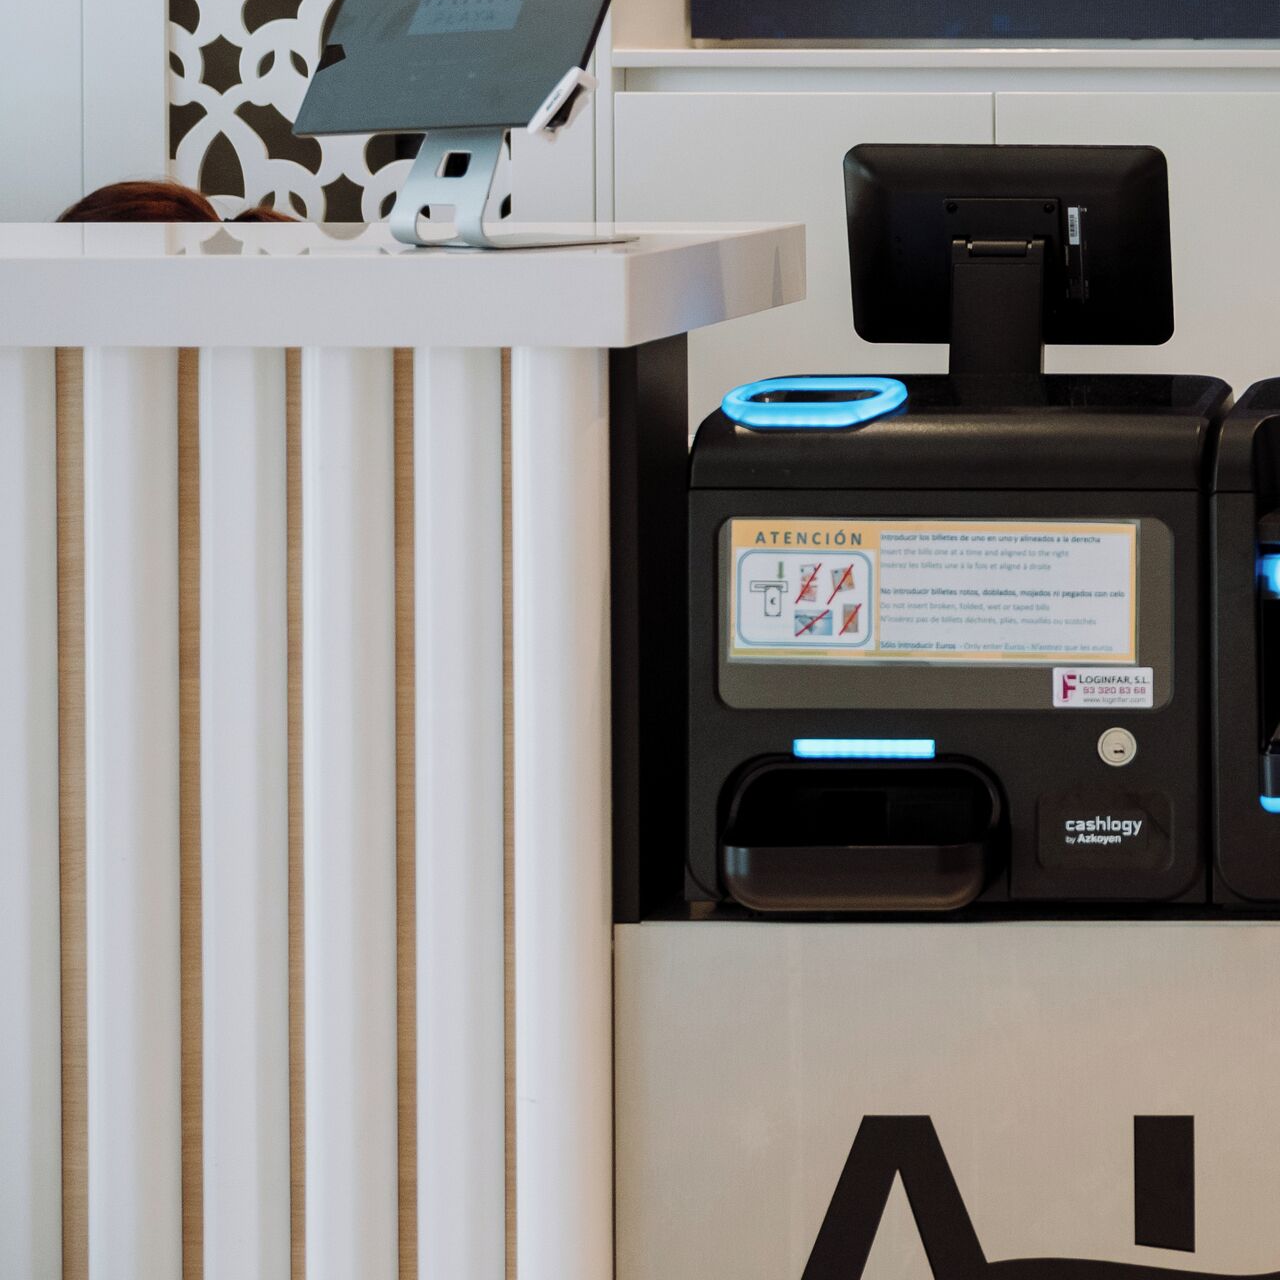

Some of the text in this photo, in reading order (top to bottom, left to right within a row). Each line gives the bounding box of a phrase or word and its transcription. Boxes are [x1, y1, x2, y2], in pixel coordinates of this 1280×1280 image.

[755, 529, 862, 545] ATENCIÓN
[1065, 816, 1142, 836] cashlogy
[1065, 833, 1121, 845] by Azkoyen
